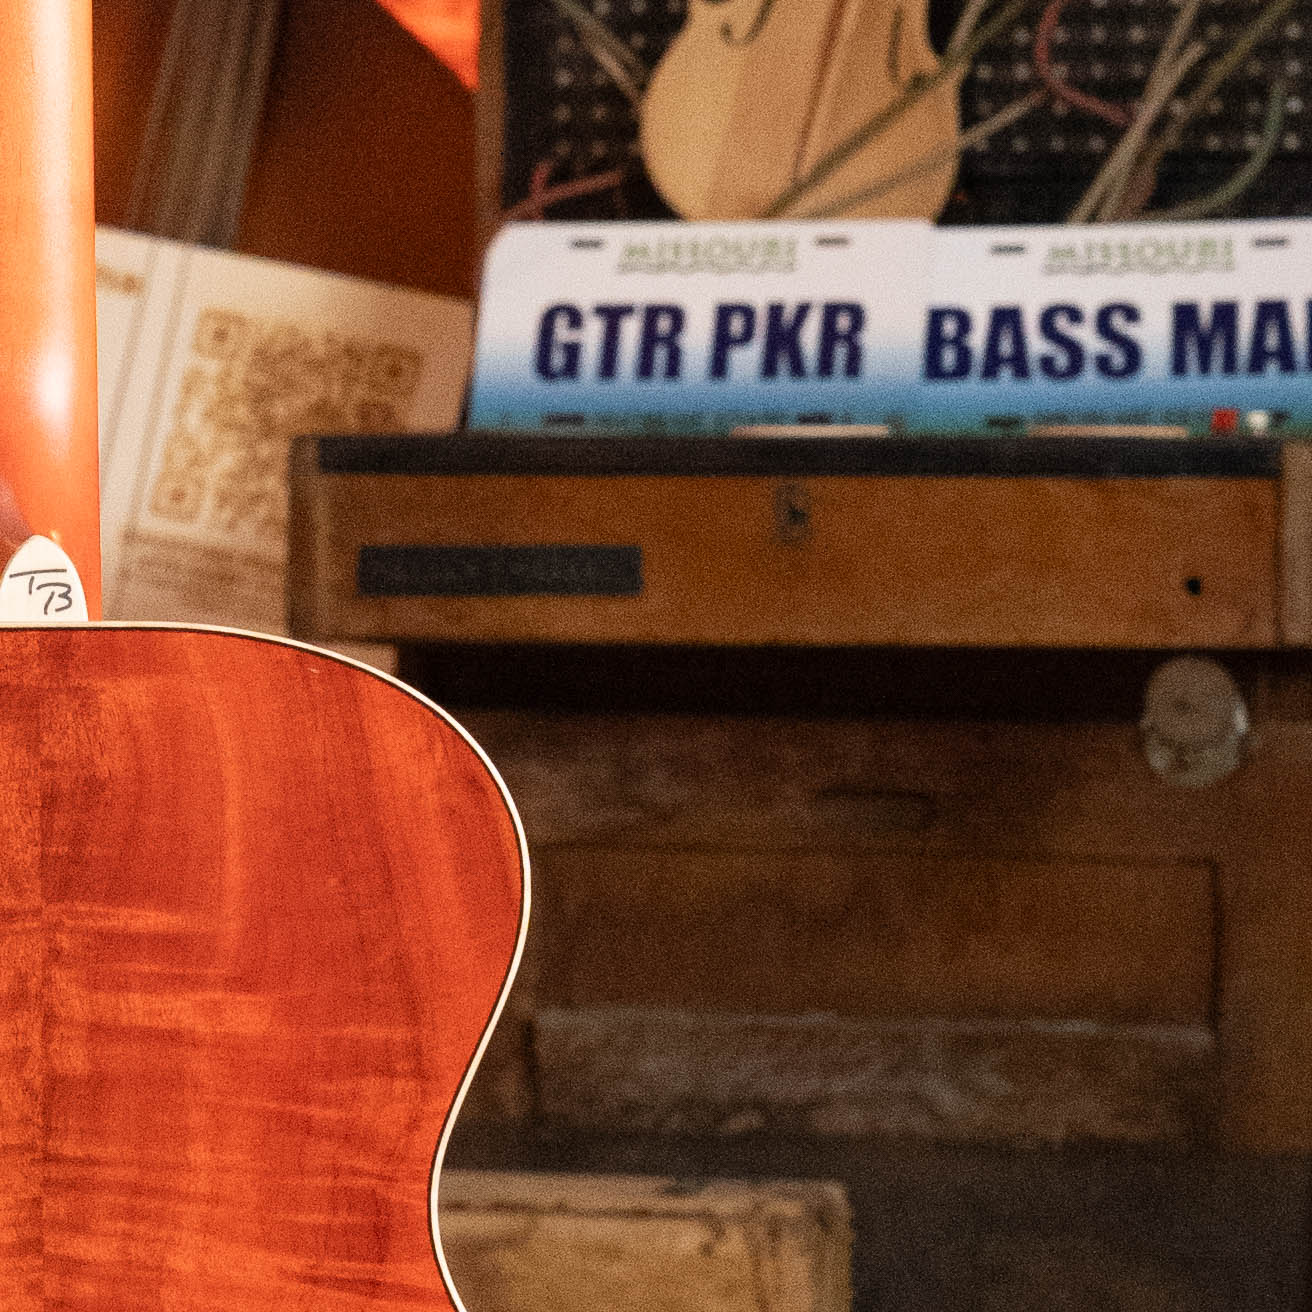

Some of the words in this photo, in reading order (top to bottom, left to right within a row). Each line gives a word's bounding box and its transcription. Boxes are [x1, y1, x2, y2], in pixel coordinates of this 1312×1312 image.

[618, 239, 799, 265] MISSOURI
[1045, 239, 1237, 265] MISSOURI
[534, 301, 686, 382] GTR
[708, 301, 867, 381] PKR
[921, 303, 1143, 381] BASS
[1170, 299, 1312, 378] MA
